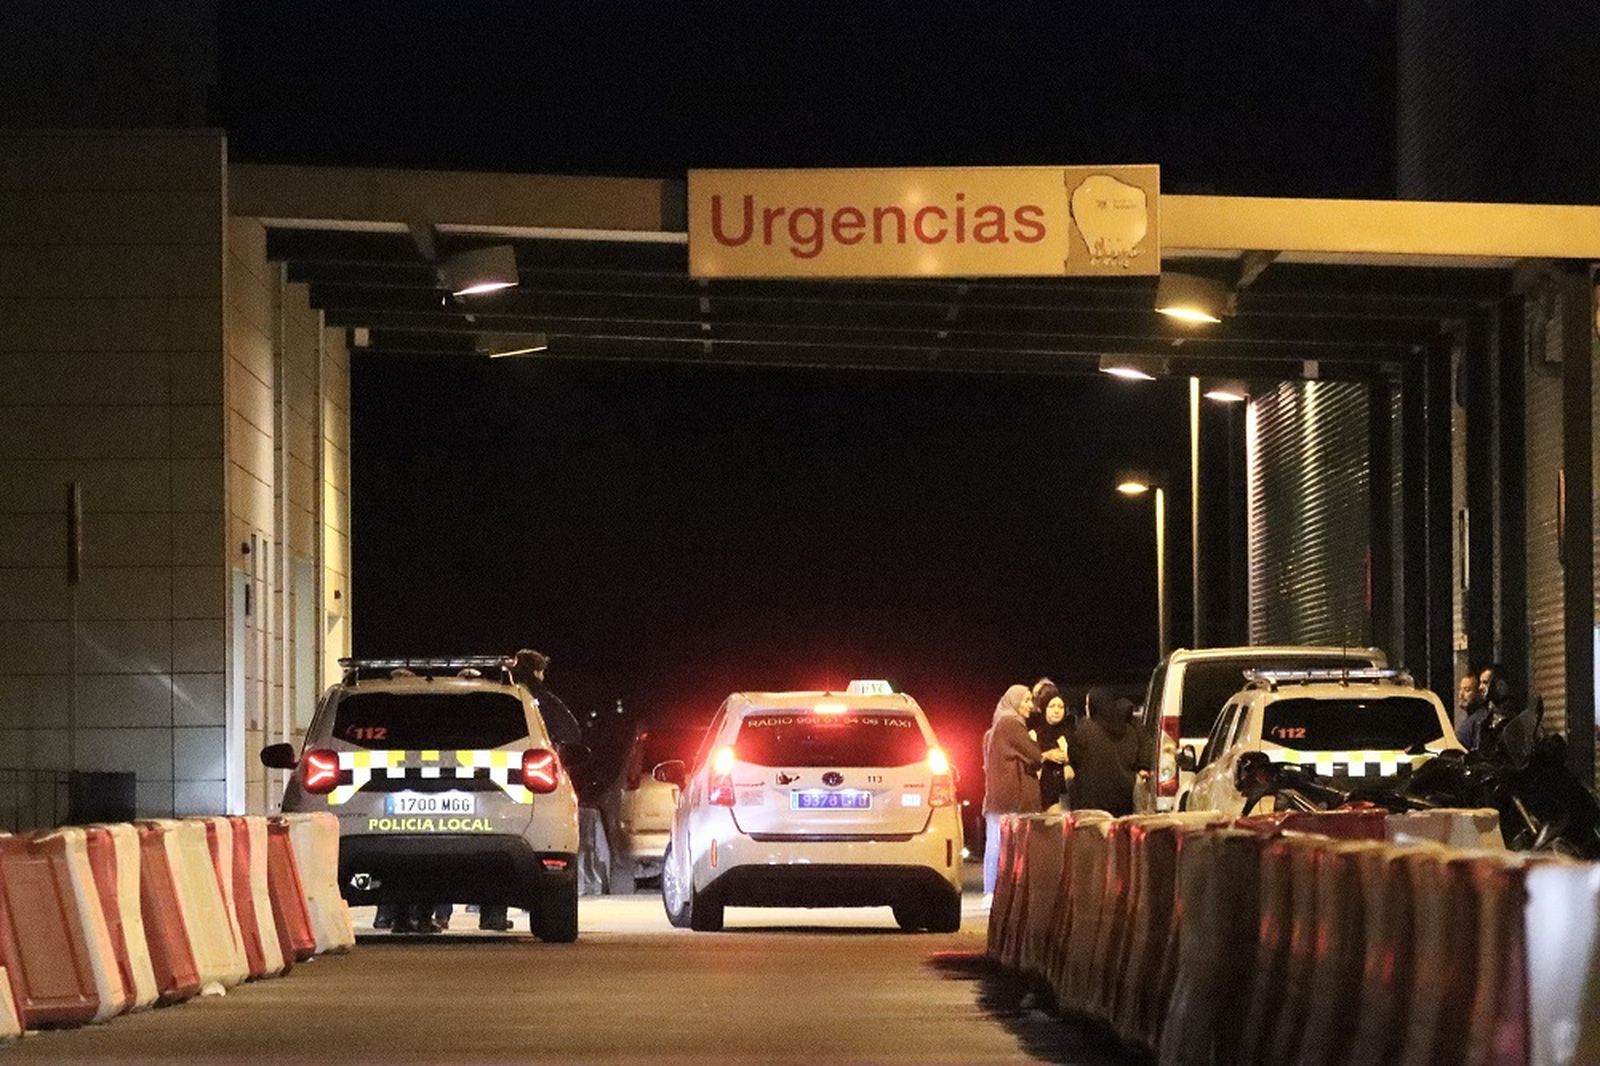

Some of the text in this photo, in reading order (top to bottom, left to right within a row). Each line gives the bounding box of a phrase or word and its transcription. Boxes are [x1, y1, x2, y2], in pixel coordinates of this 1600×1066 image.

[710, 192, 1047, 259] Urgencias
[748, 717, 793, 728] RADIO
[883, 717, 912, 729] TAXI
[354, 728, 386, 739] 112
[1278, 728, 1306, 738] 112
[867, 775, 882, 783] 113
[400, 798, 470, 811] 1700 MGG
[802, 794, 838, 807] 9378
[368, 818, 493, 831] POLICIA LOCAL
